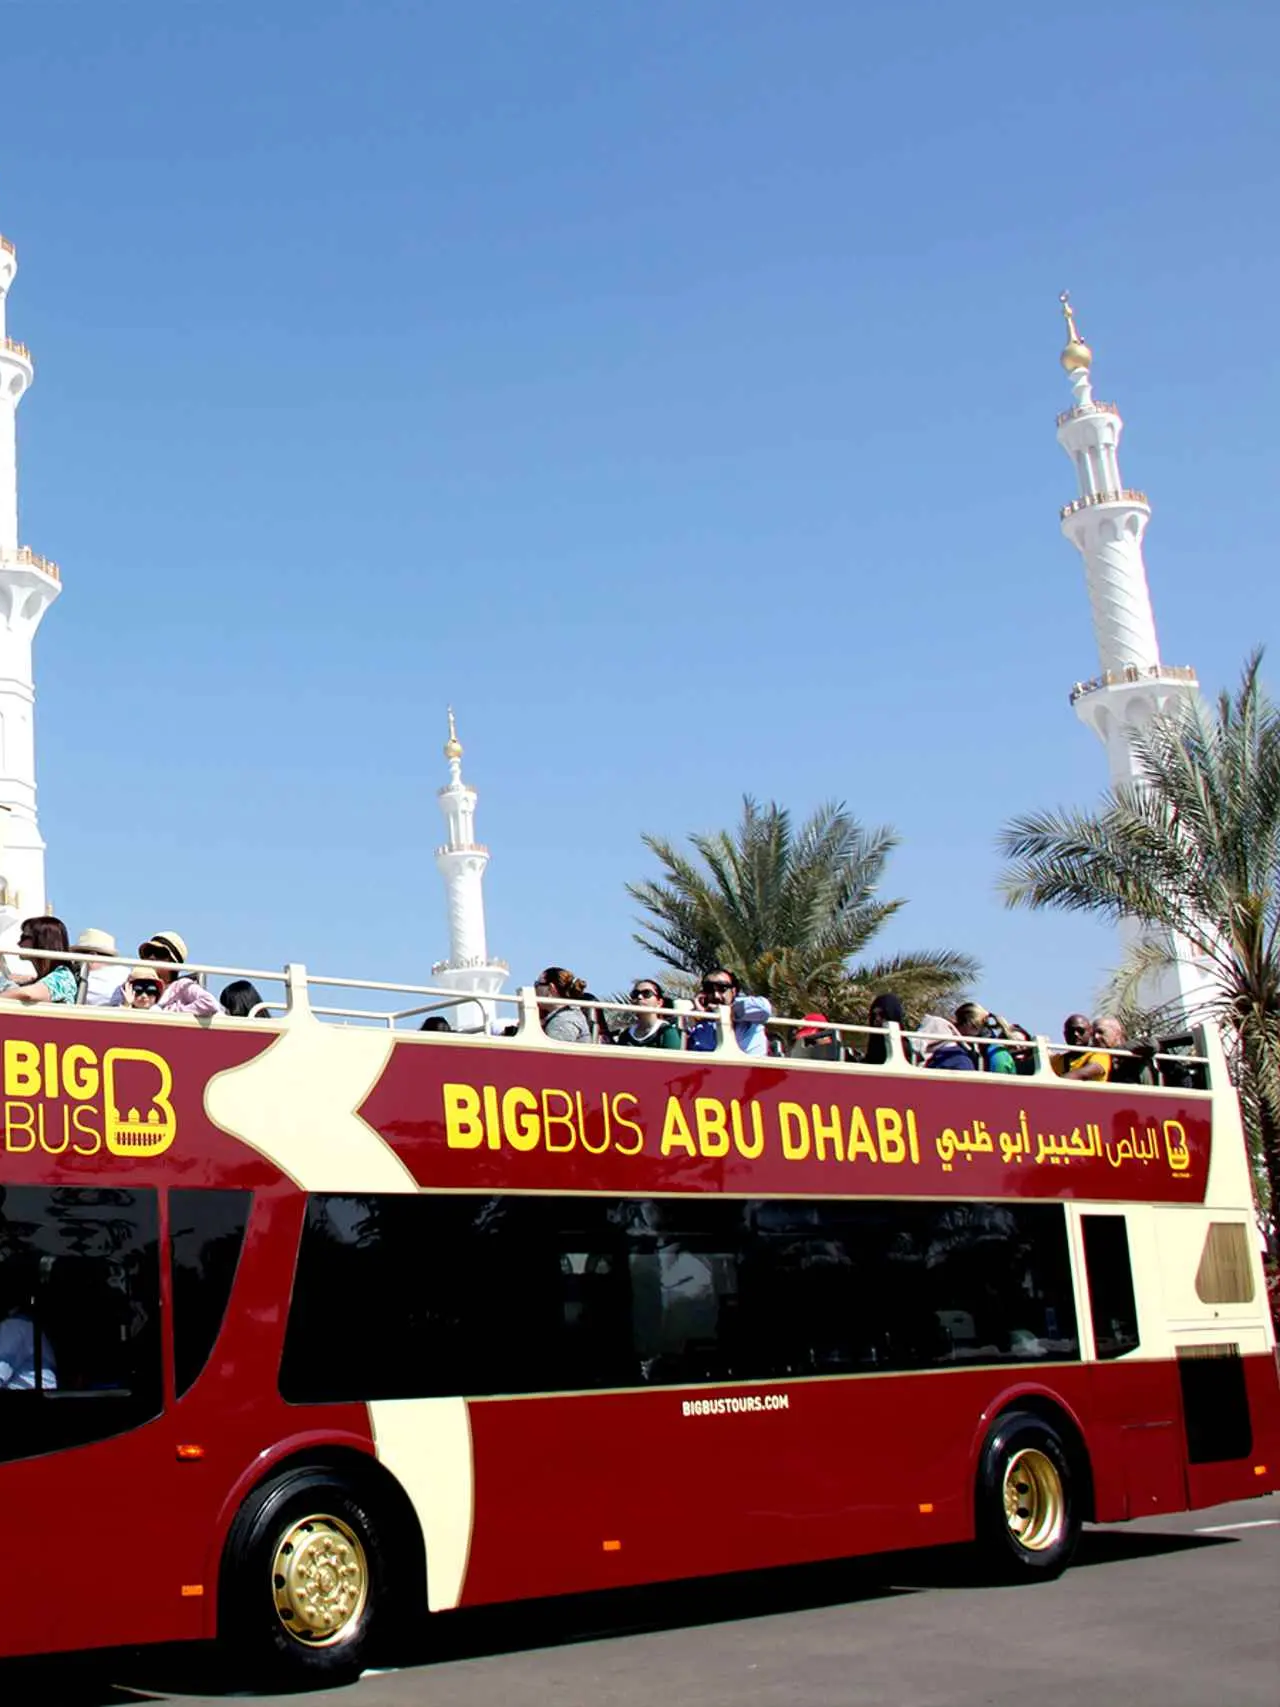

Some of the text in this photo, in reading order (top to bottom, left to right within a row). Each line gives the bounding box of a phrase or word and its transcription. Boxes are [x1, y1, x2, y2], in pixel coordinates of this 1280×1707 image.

[4, 1039, 99, 1100] BIG
[5, 1101, 101, 1155] BUS
[660, 1096, 765, 1159] ABU
[778, 1101, 920, 1164] DHABI
[936, 1110, 1160, 1172] الباص الكبير أبو ظبي
[682, 1394, 789, 1416] BIGBUSTOURS.COM
